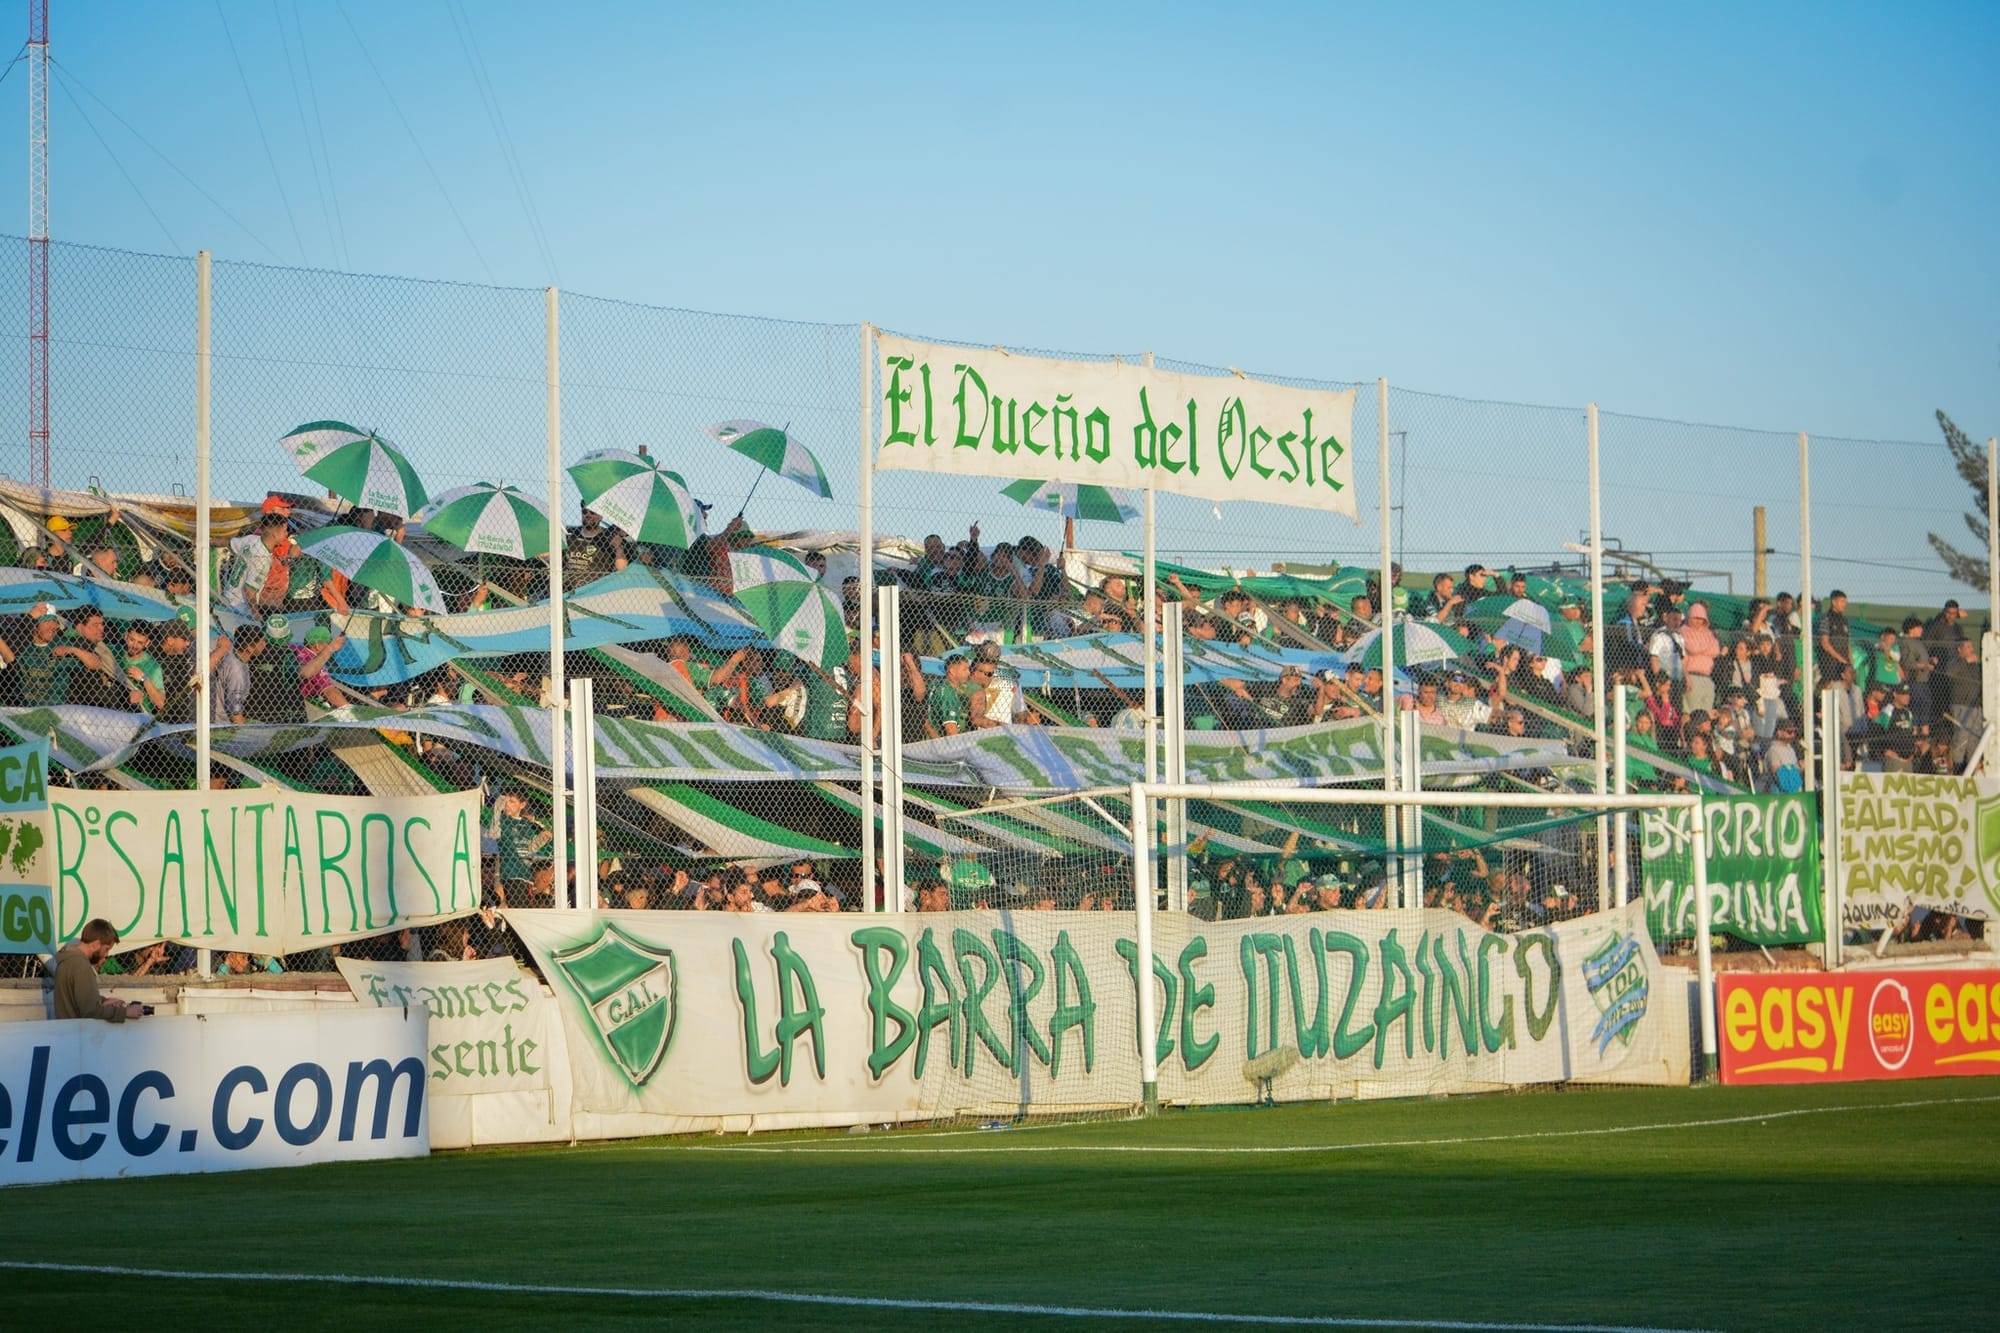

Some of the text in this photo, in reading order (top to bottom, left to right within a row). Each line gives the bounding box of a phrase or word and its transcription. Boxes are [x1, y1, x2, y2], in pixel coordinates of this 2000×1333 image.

[884, 353, 1344, 492] El Dueño del Oeste
[1882, 774, 1979, 802] MISMA
[1841, 797, 1969, 835] EALTAD,
[1841, 833, 1963, 865] L MISMO
[0, 893, 51, 946] GO
[732, 926, 1561, 1087] LA BARRA DE ITUZAINGO
[1606, 962, 1639, 1004] 100
[428, 1023, 541, 1081] sente
[1725, 986, 1854, 1071] easy
[1873, 1012, 1909, 1039] easy
[0, 1045, 426, 1163] lec.com
